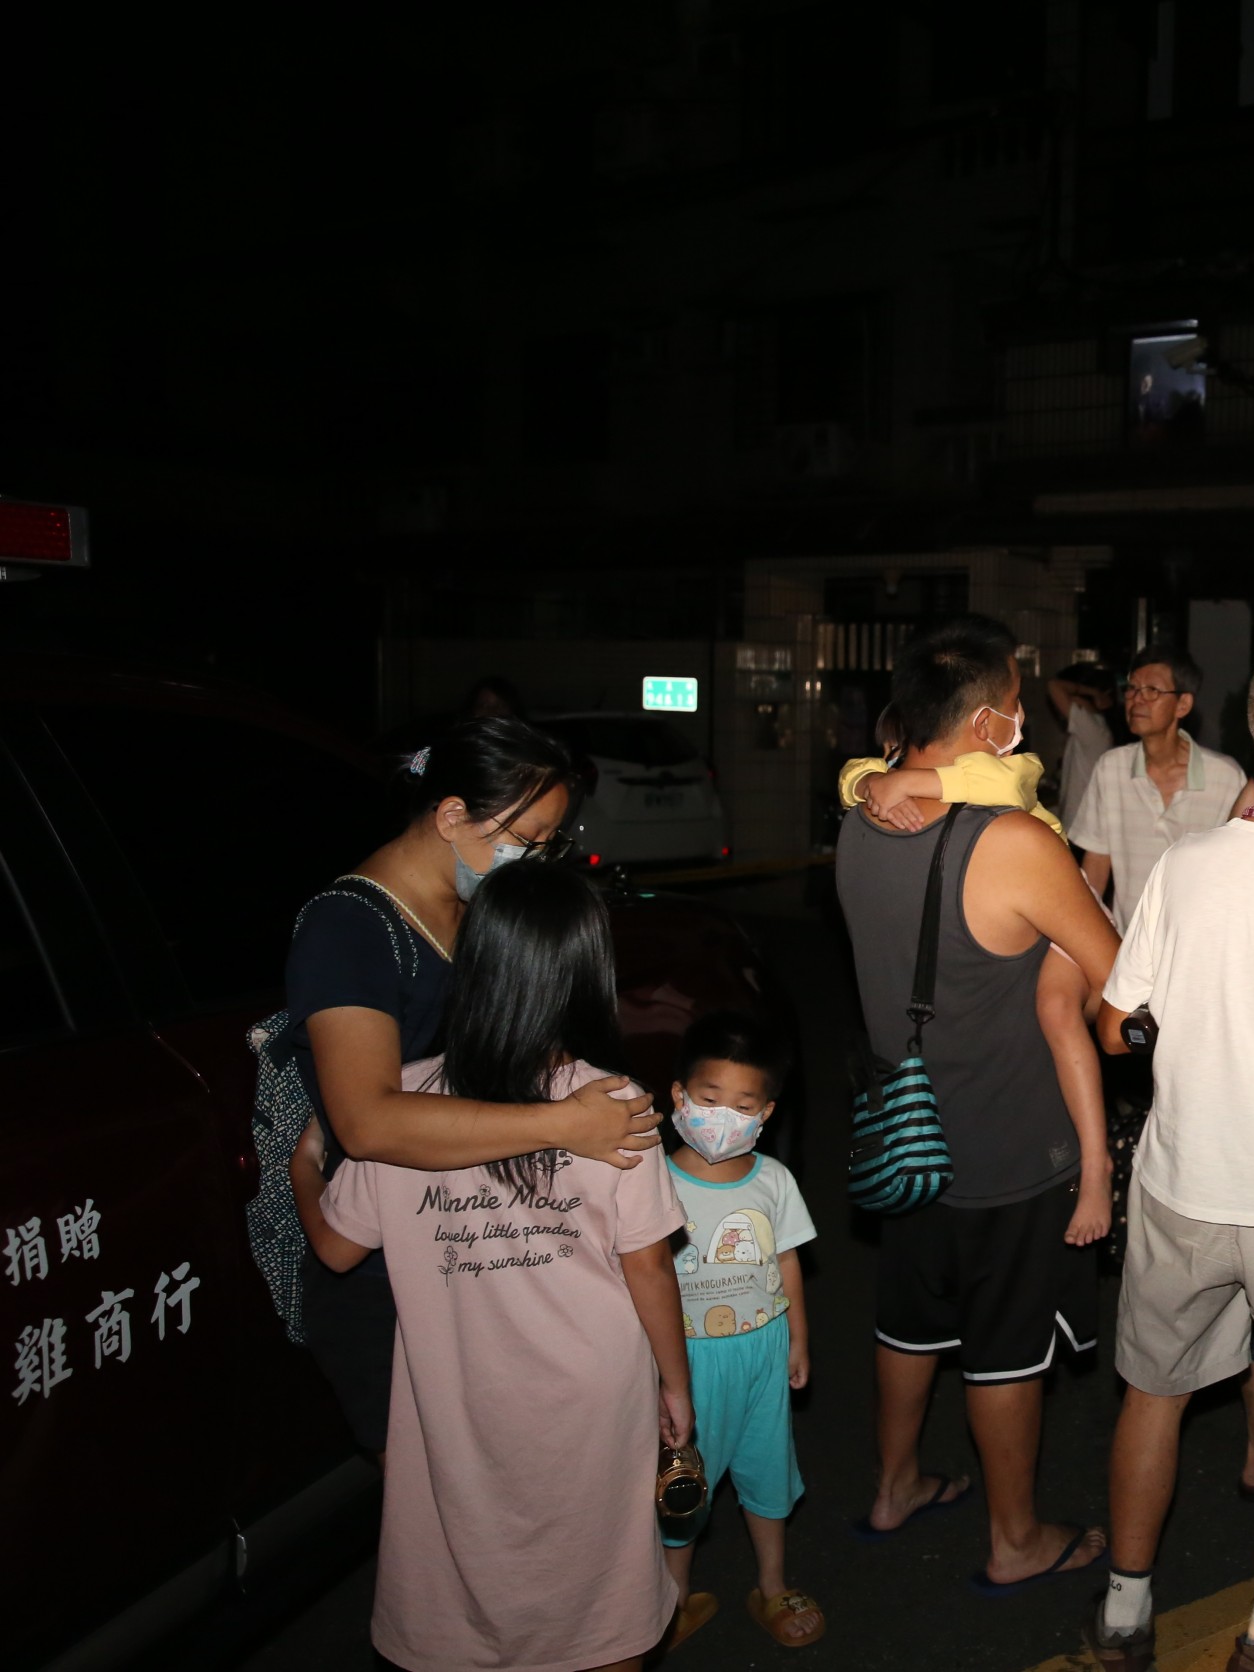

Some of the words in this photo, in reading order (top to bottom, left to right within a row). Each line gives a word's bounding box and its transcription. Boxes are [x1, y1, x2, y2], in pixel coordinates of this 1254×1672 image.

[416, 1185, 502, 1215] Minnie
[3, 1198, 102, 1287] 捐贈
[435, 1225, 479, 1249] lovely
[482, 1222, 520, 1240] little
[523, 1223, 582, 1243] garden
[458, 1262, 485, 1278] my
[487, 1250, 554, 1271] sunshine
[680, 1274, 746, 1292] UMIKKOGURASHI
[11, 1261, 201, 1407] 雞商行
